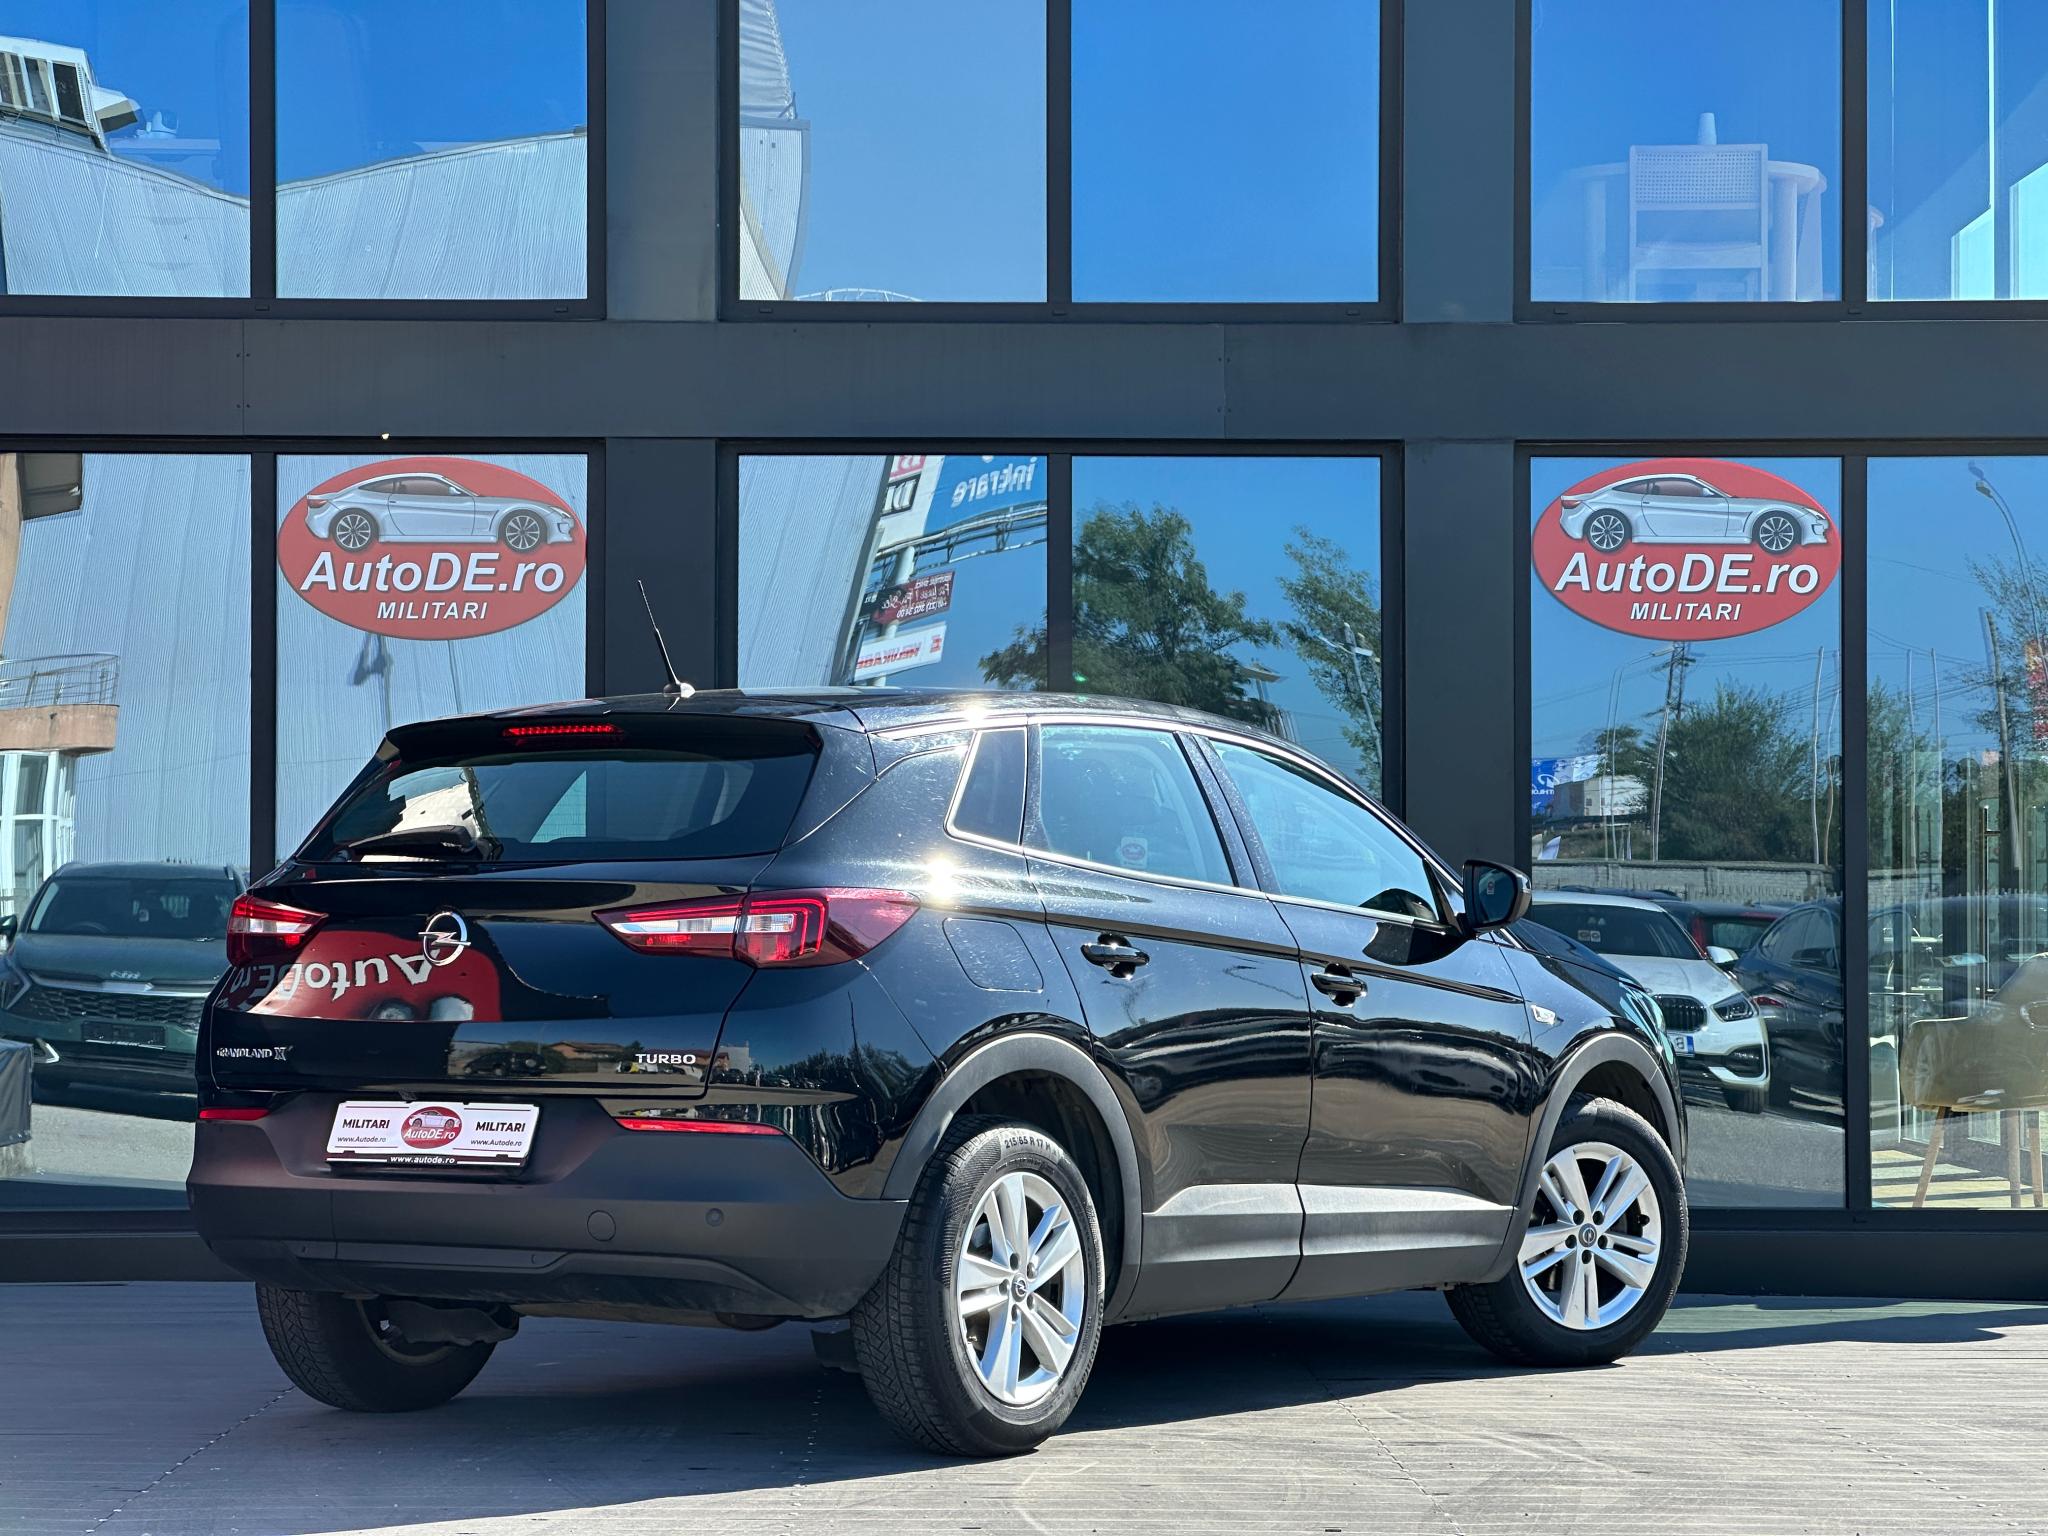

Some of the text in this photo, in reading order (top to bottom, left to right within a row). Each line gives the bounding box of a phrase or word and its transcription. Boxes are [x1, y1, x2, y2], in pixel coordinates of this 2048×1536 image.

[300, 551, 565, 593] AutoDE.ro
[1554, 552, 1819, 594] AutoDE.ro
[377, 601, 488, 620] MILITARI
[1630, 602, 1742, 621] MILITARI
[273, 1046, 287, 1061] X
[635, 1053, 697, 1065] TURBO
[342, 1119, 391, 1129] MILITARI
[475, 1121, 526, 1132] MILITARI
[403, 1128, 456, 1140] AutoDE.ro
[470, 1139, 522, 1147] www.Autode.ro
[390, 1156, 455, 1164] www.autode.ro
